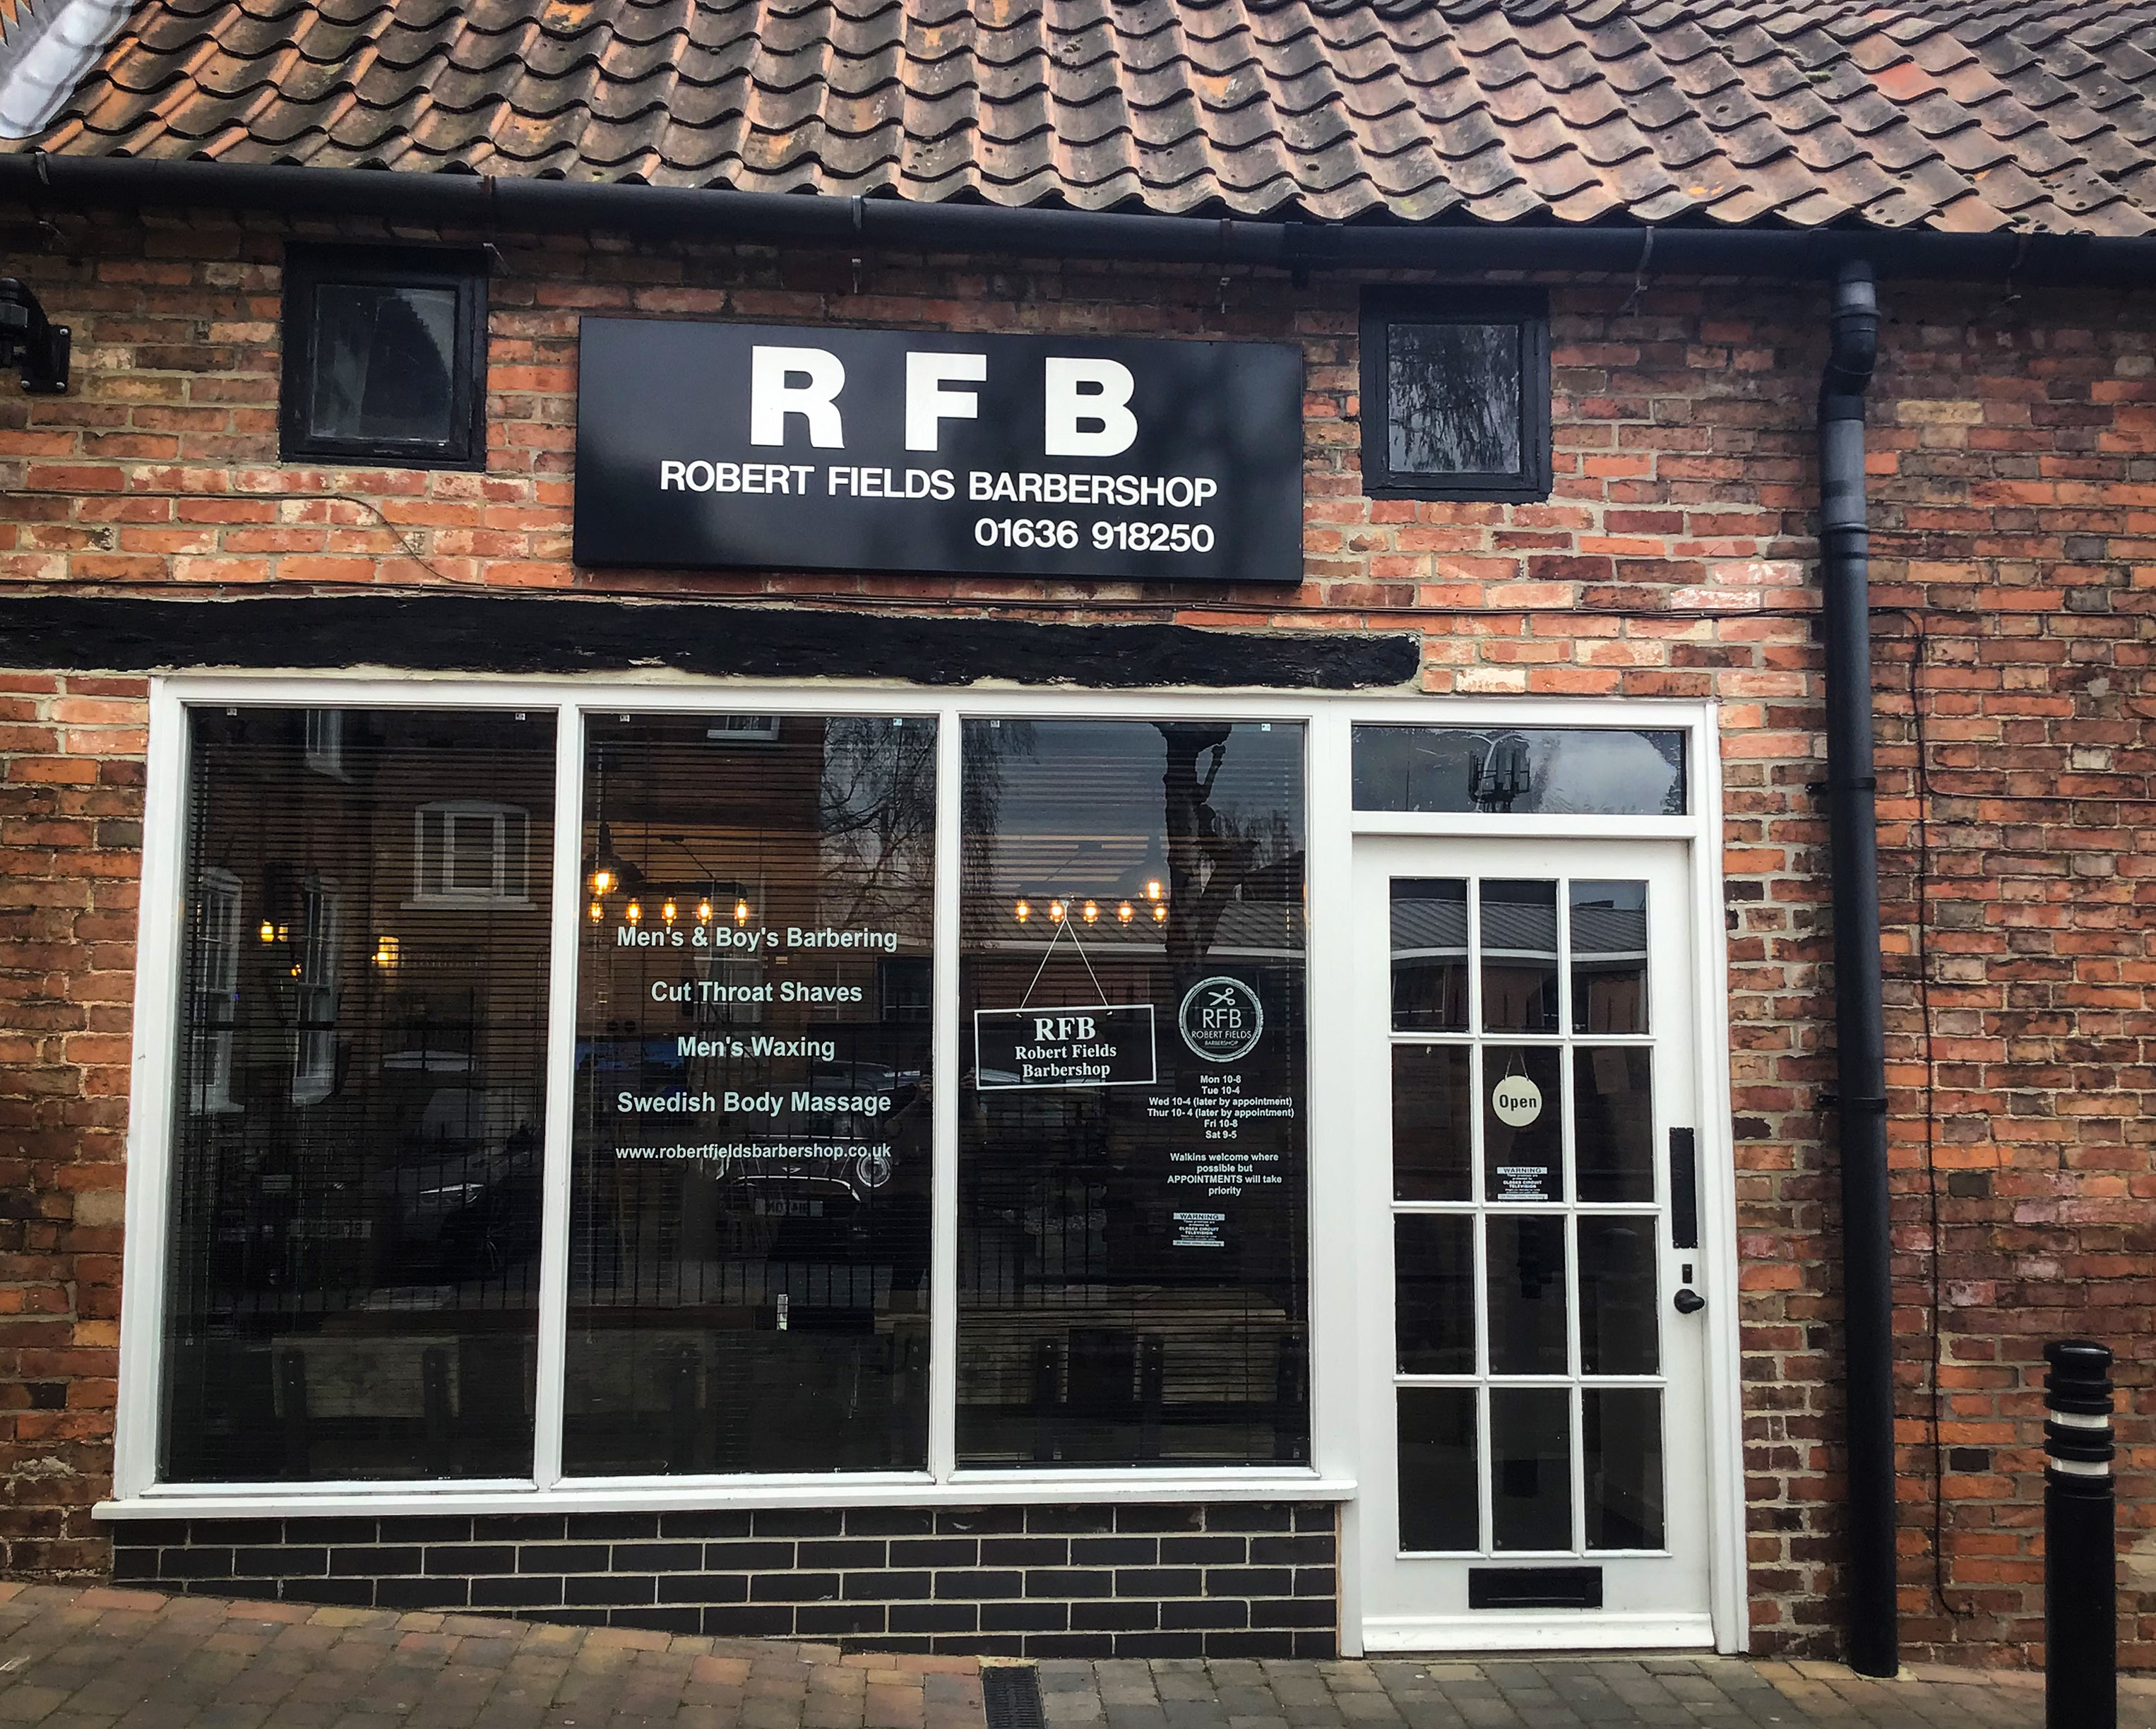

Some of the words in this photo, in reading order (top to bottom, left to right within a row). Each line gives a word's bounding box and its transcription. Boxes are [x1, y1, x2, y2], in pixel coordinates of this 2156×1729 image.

[661, 461, 814, 494] ROBERT
[829, 468, 955, 500] FIELDS
[970, 472, 1217, 507] BARBERSHOP
[975, 518, 1078, 549] 01636
[1092, 521, 1214, 552] 918250
[618, 927, 684, 946] Men's
[692, 927, 708, 946] &
[717, 927, 778, 951] Boy's
[787, 927, 898, 952] Barbering
[652, 981, 691, 1001] Cut
[698, 982, 773, 1002] Throat
[780, 982, 862, 1001] Shaves
[1203, 1009, 1241, 1028] RFB
[1034, 1017, 1095, 1040] RFB
[1191, 1030, 1223, 1040] ROBERT
[1225, 1030, 1252, 1040] FIELDS
[678, 1037, 743, 1057] Men's
[751, 1037, 834, 1061] Waxing
[1016, 1046, 1067, 1059] Robert
[1072, 1044, 1116, 1057] Fields
[1023, 1063, 1110, 1078] Barbershop
[1200, 1075, 1220, 1083] Mon
[1222, 1075, 1241, 1084] 10-8
[1201, 1086, 1219, 1095] Tue
[1221, 1086, 1241, 1095] 10-4
[618, 1092, 715, 1112] Swedish
[725, 1092, 783, 1117] Body
[792, 1092, 891, 1116] Massage
[1148, 1097, 1169, 1106] Wed
[1172, 1097, 1191, 1106] 10-4
[1193, 1098, 1217, 1107] (later
[1219, 1098, 1230, 1107] by
[1232, 1097, 1292, 1107] appointment)
[1499, 1094, 1537, 1111] Open
[1146, 1107, 1169, 1117] Thur
[1195, 1108, 1220, 1119] (later
[1220, 1108, 1232, 1119] by
[1234, 1108, 1294, 1119] appointment)
[1204, 1119, 1217, 1128] Fri
[1219, 1119, 1239, 1128] 10-8
[1205, 1130, 1221, 1139] Sat
[1222, 1130, 1237, 1139] 9-5
[616, 1143, 891, 1161] www.robertfieldsbarbershop.co.uk
[1169, 1152, 1207, 1161] Walkins
[1208, 1153, 1249, 1162] welcome
[1250, 1152, 1279, 1161] where
[1196, 1164, 1236, 1175] possible
[1237, 1163, 1253, 1172] but
[1167, 1175, 1243, 1184] APPOINTMENTS
[1244, 1175, 1261, 1184] will
[1262, 1175, 1282, 1184] take
[1208, 1187, 1241, 1196] priority
